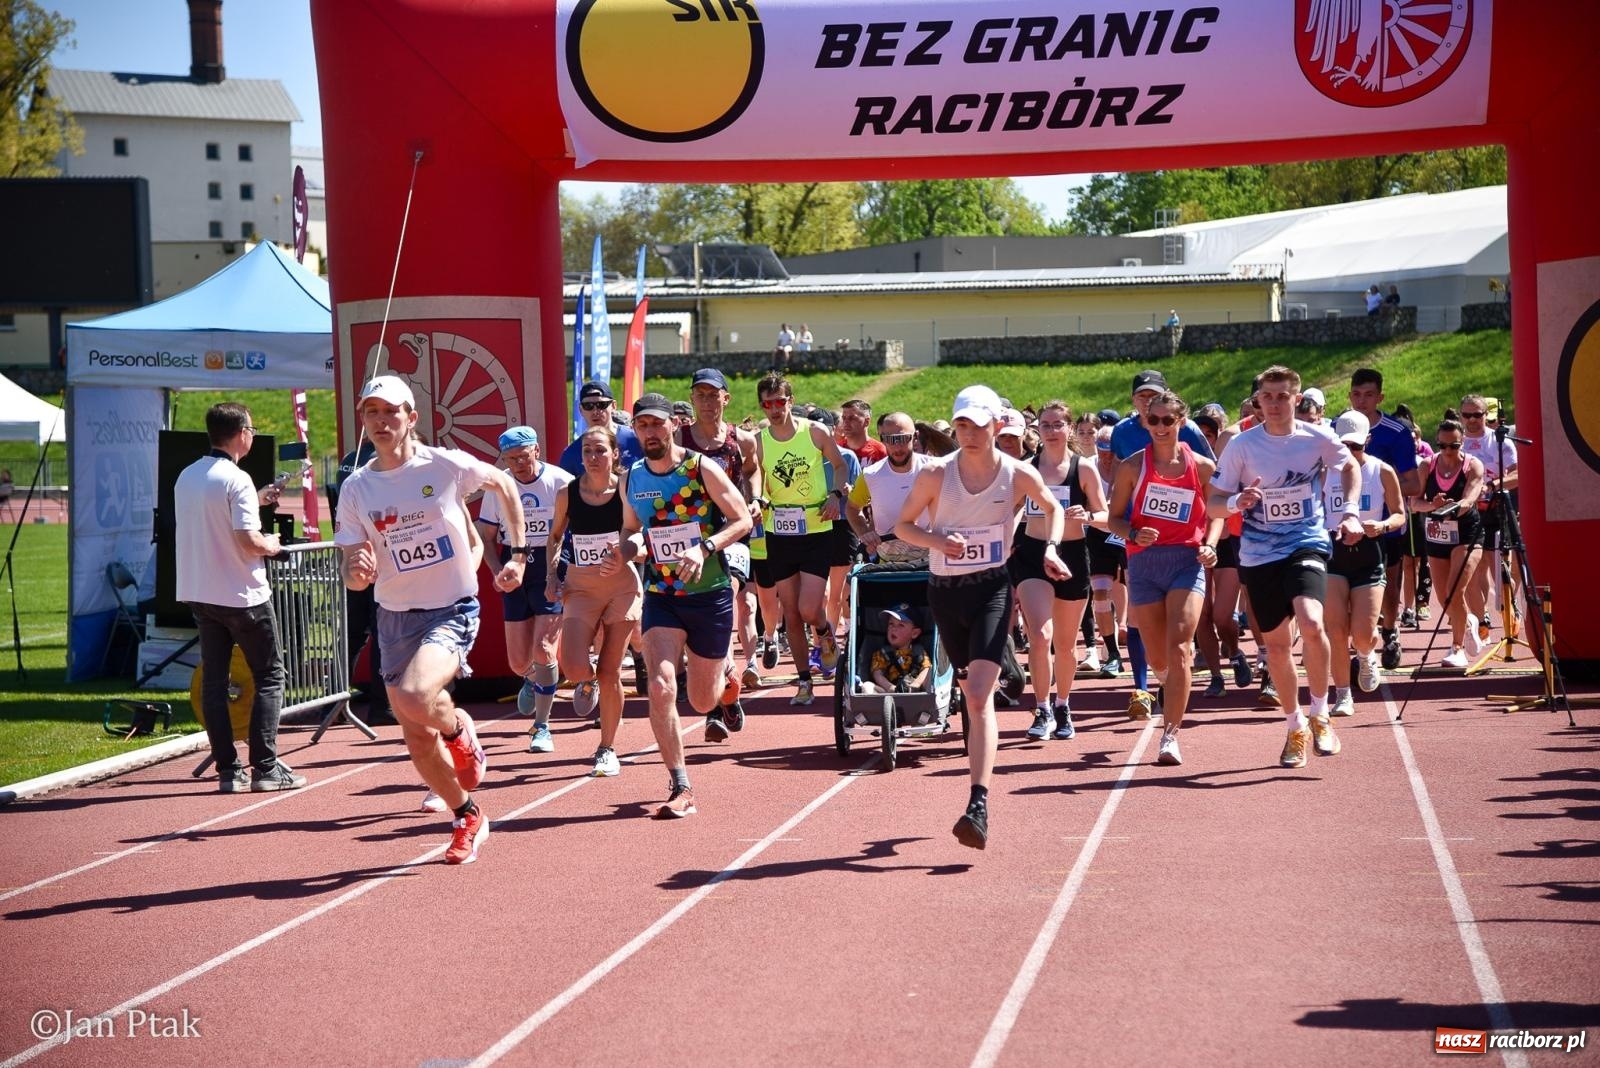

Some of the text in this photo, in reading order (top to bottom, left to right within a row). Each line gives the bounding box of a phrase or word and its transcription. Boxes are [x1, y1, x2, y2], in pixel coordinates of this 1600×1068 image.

[814, 6, 1220, 68] BEZ GRANIC
[849, 76, 1185, 136] RACIBÓRZ
[88, 350, 199, 368] PersonalBest
[1149, 498, 1178, 515] 058
[1270, 502, 1301, 517] 033
[776, 520, 797, 531] 069
[399, 542, 437, 564] 043
